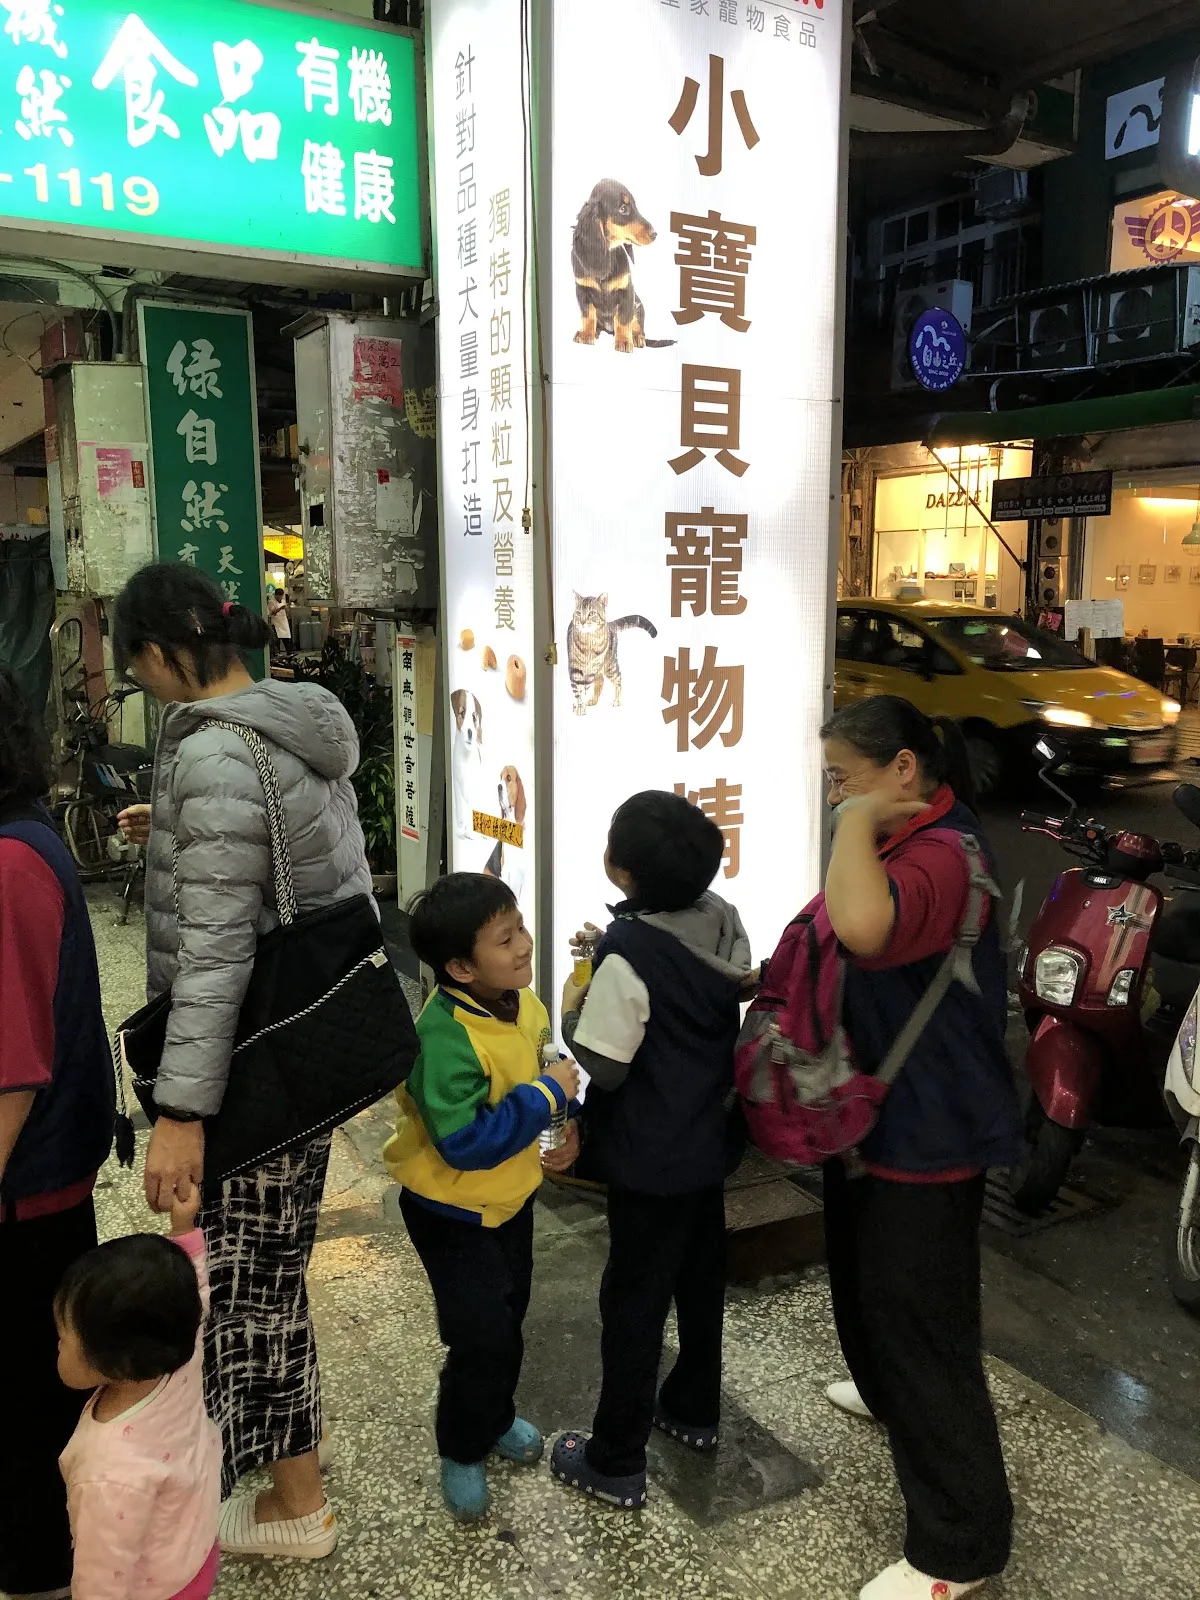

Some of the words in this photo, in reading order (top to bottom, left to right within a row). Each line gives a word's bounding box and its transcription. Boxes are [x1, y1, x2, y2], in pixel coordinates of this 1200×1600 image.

[661, 0, 816, 48] 家寵物食品
[92, 13, 281, 162] 食品
[296, 37, 392, 126] 有機
[0, 163, 160, 216] -1119
[302, 139, 396, 224] 健康
[454, 43, 483, 537] 針對品種犬量身打造
[488, 187, 516, 631] 獨特的顆粒及營養
